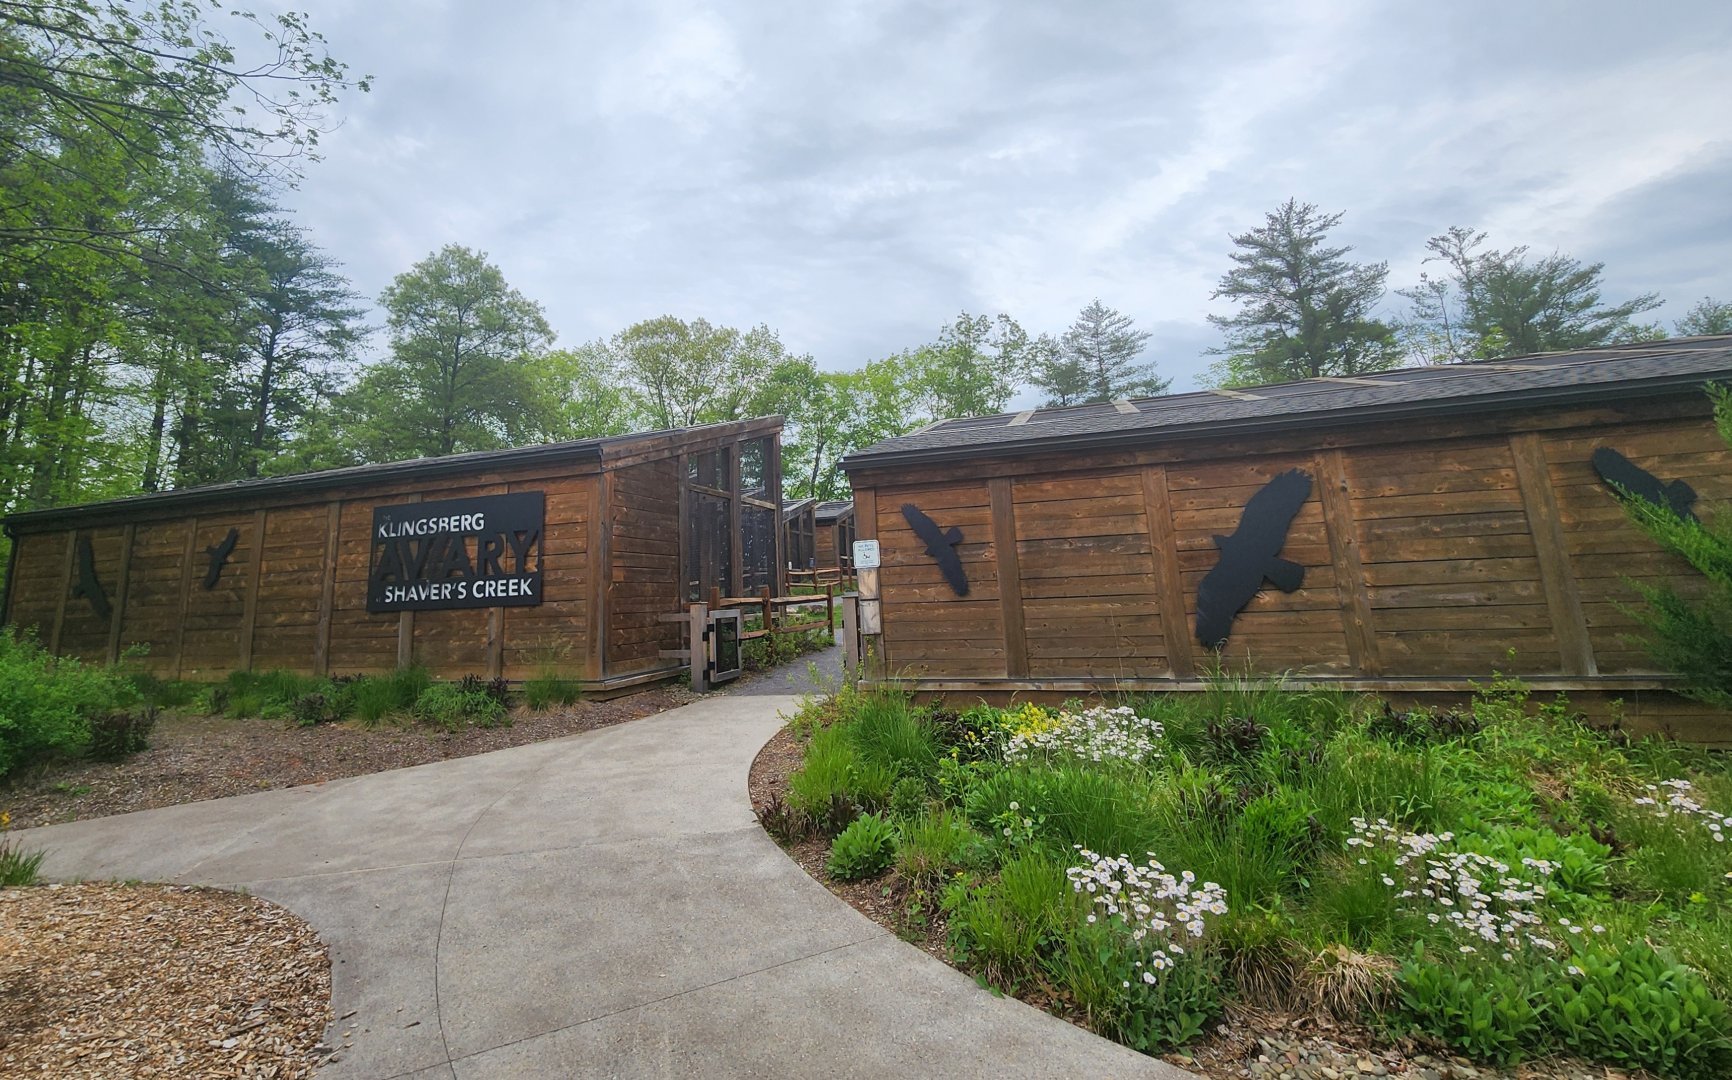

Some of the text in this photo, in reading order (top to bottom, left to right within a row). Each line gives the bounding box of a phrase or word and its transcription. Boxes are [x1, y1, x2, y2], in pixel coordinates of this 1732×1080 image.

[378, 512, 485, 538] KLINGSBERG
[384, 577, 533, 603] SHAVER'S CREEK
